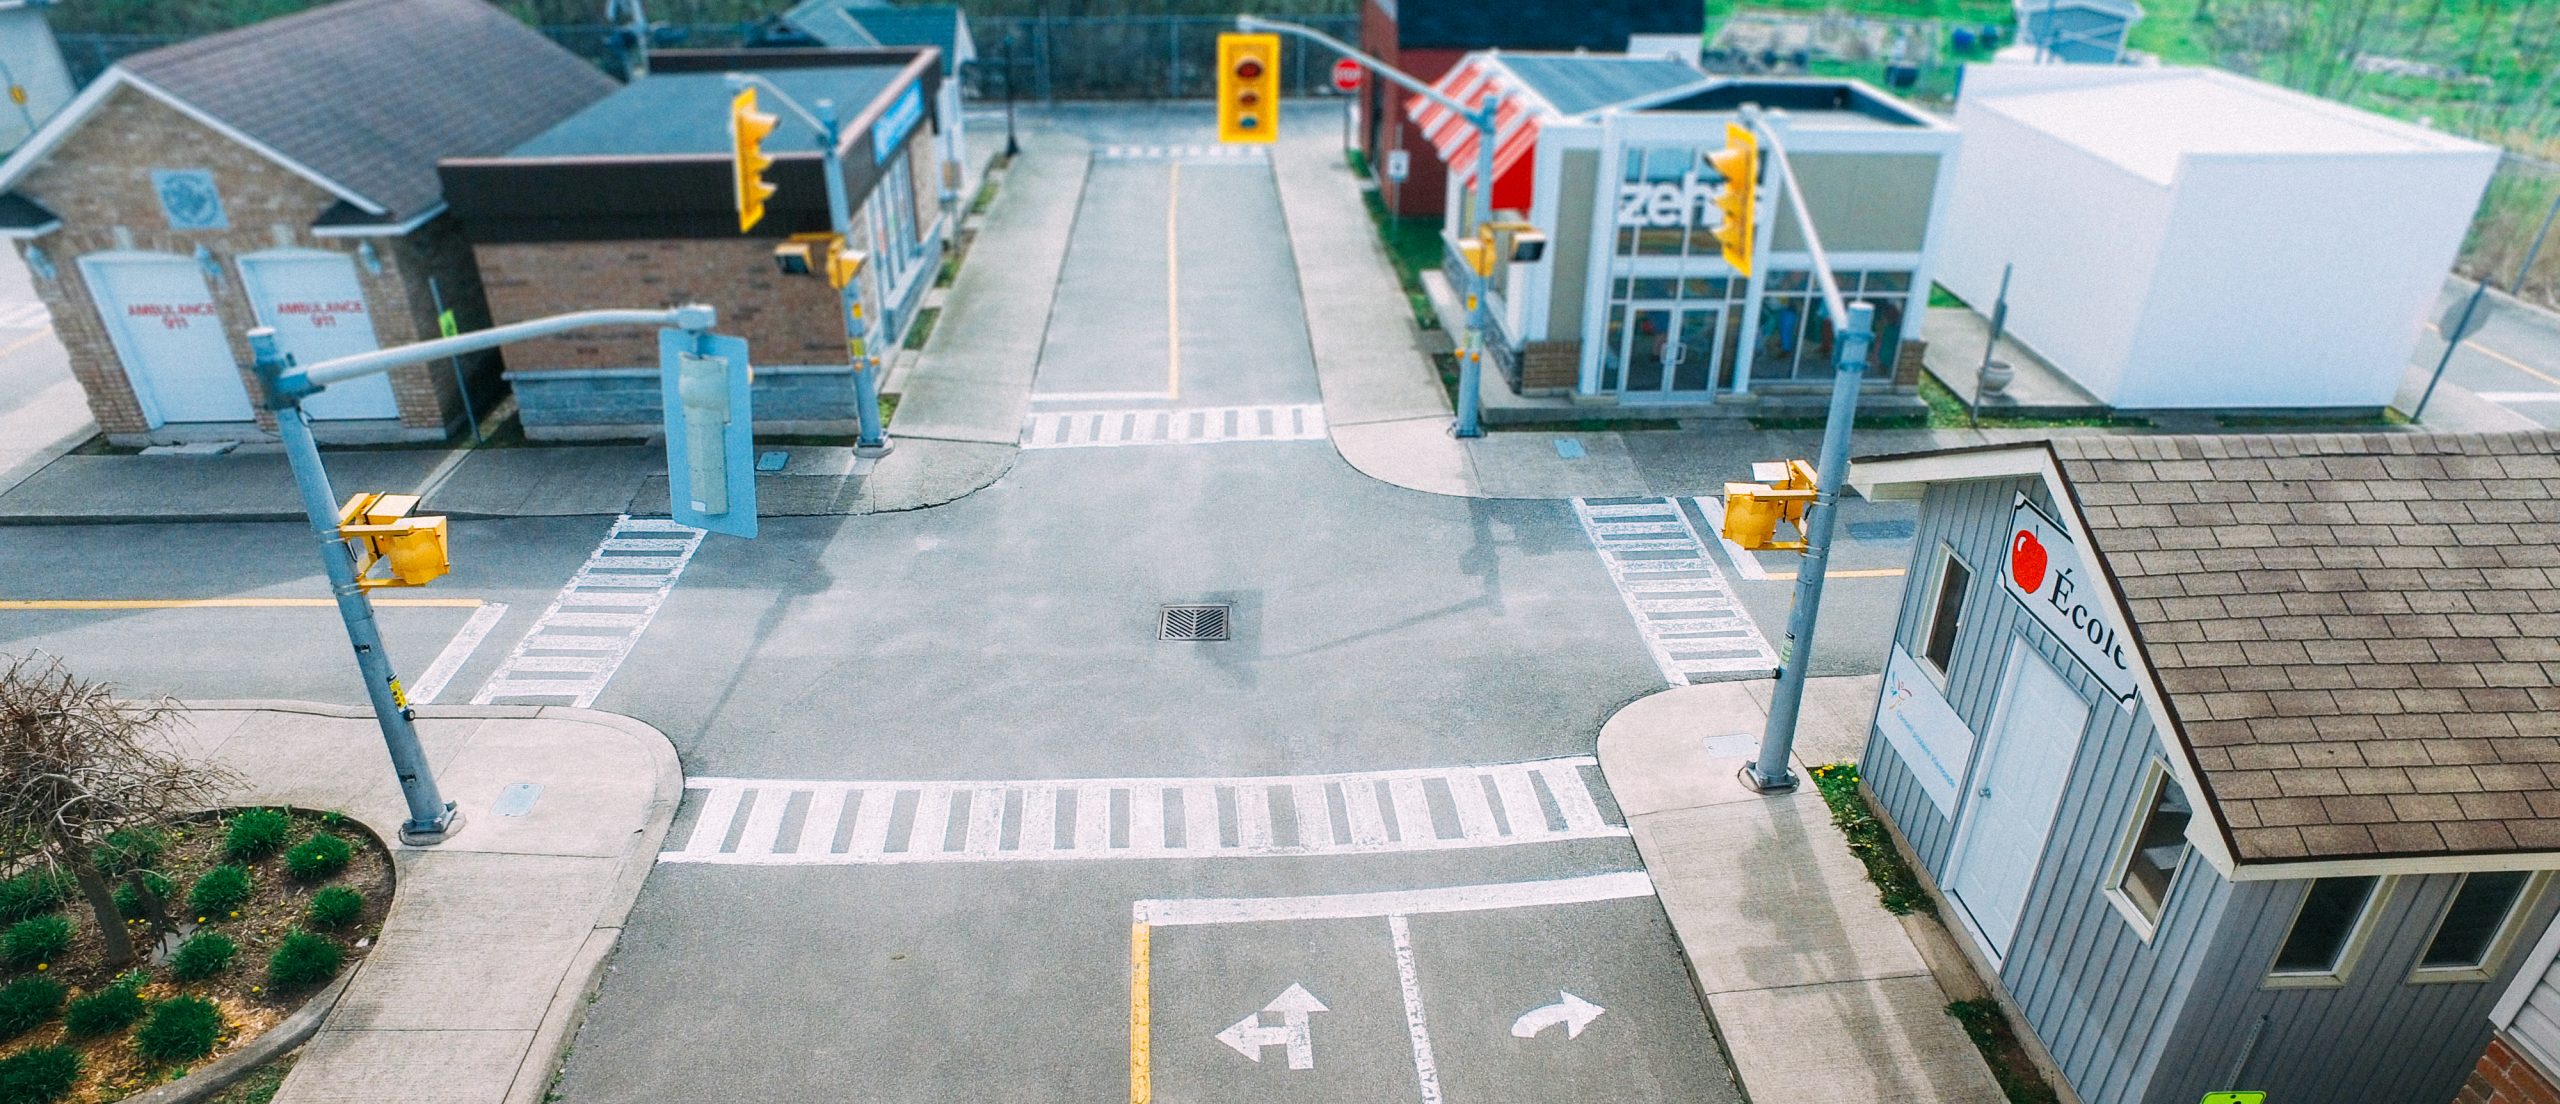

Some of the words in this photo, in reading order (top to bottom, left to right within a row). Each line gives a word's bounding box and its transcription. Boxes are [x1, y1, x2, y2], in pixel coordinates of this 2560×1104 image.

[1333, 68, 1361, 81] STOP
[128, 303, 215, 316] AMBULANCE
[277, 300, 363, 314] AMBULANCE
[163, 315, 188, 329] 911
[311, 313, 337, 328] 911
